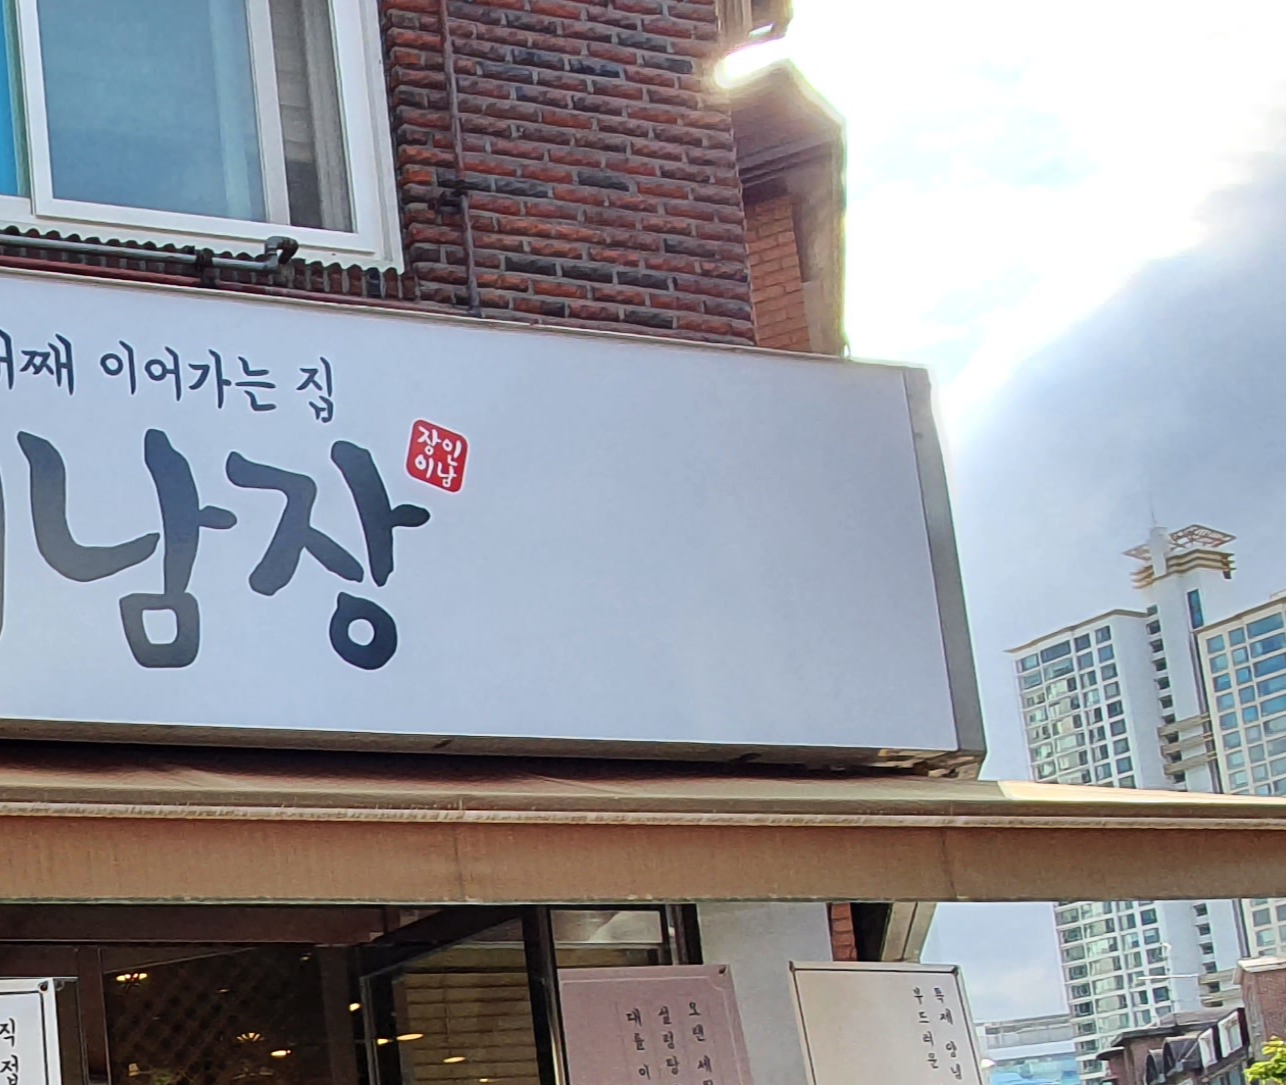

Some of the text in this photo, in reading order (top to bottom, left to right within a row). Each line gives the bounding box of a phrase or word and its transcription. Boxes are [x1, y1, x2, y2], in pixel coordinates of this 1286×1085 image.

[100, 340, 277, 412] 이어가는
[296, 357, 335, 423] 집
[627, 1008, 645, 1051] 대를
[689, 1002, 705, 1041] 오랜
[913, 987, 939, 1069] 부드러운
